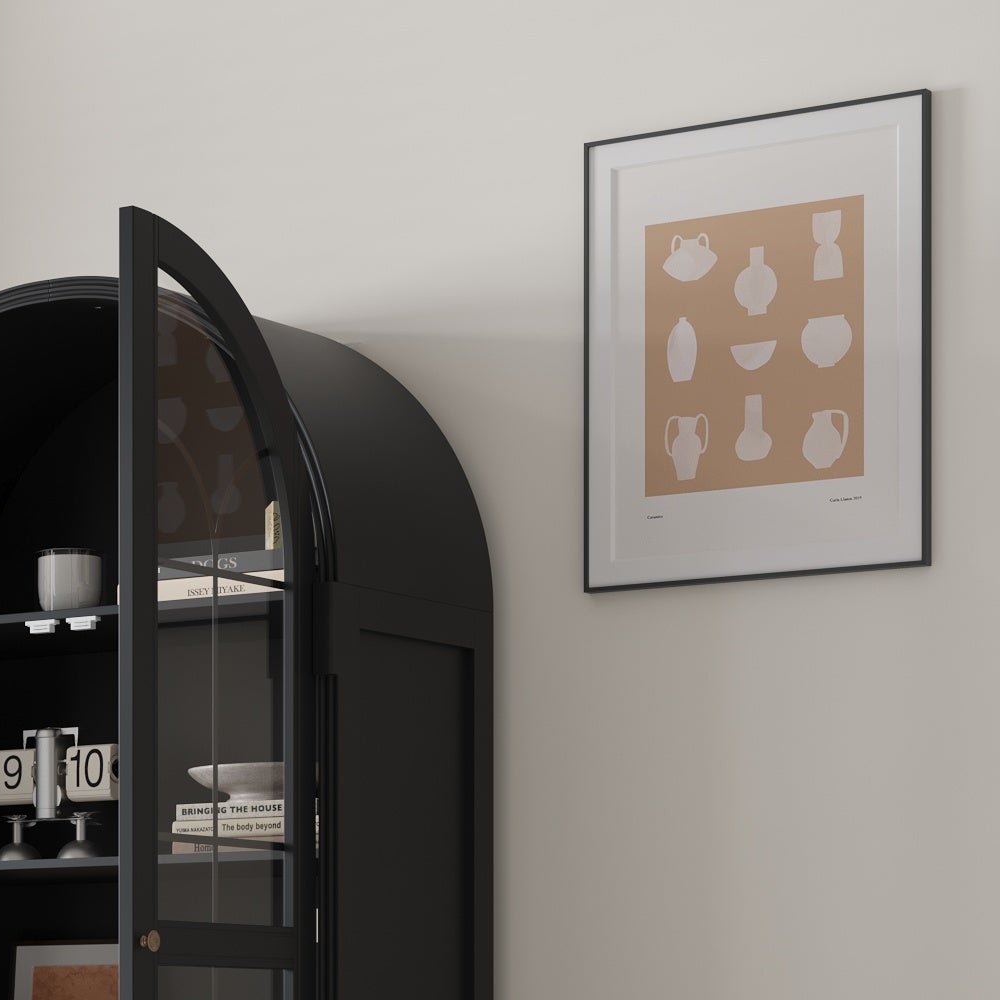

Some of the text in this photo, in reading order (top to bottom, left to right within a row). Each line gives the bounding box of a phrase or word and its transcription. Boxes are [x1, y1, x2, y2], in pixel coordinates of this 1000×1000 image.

[187, 584, 246, 597] ISSEY IYAKE
[3, 755, 22, 789] 9
[70, 748, 103, 788] 10
[181, 803, 283, 816] BRINGIG THE HOUSE
[222, 821, 282, 832] The body beyond
[194, 842, 214, 852] Hom
